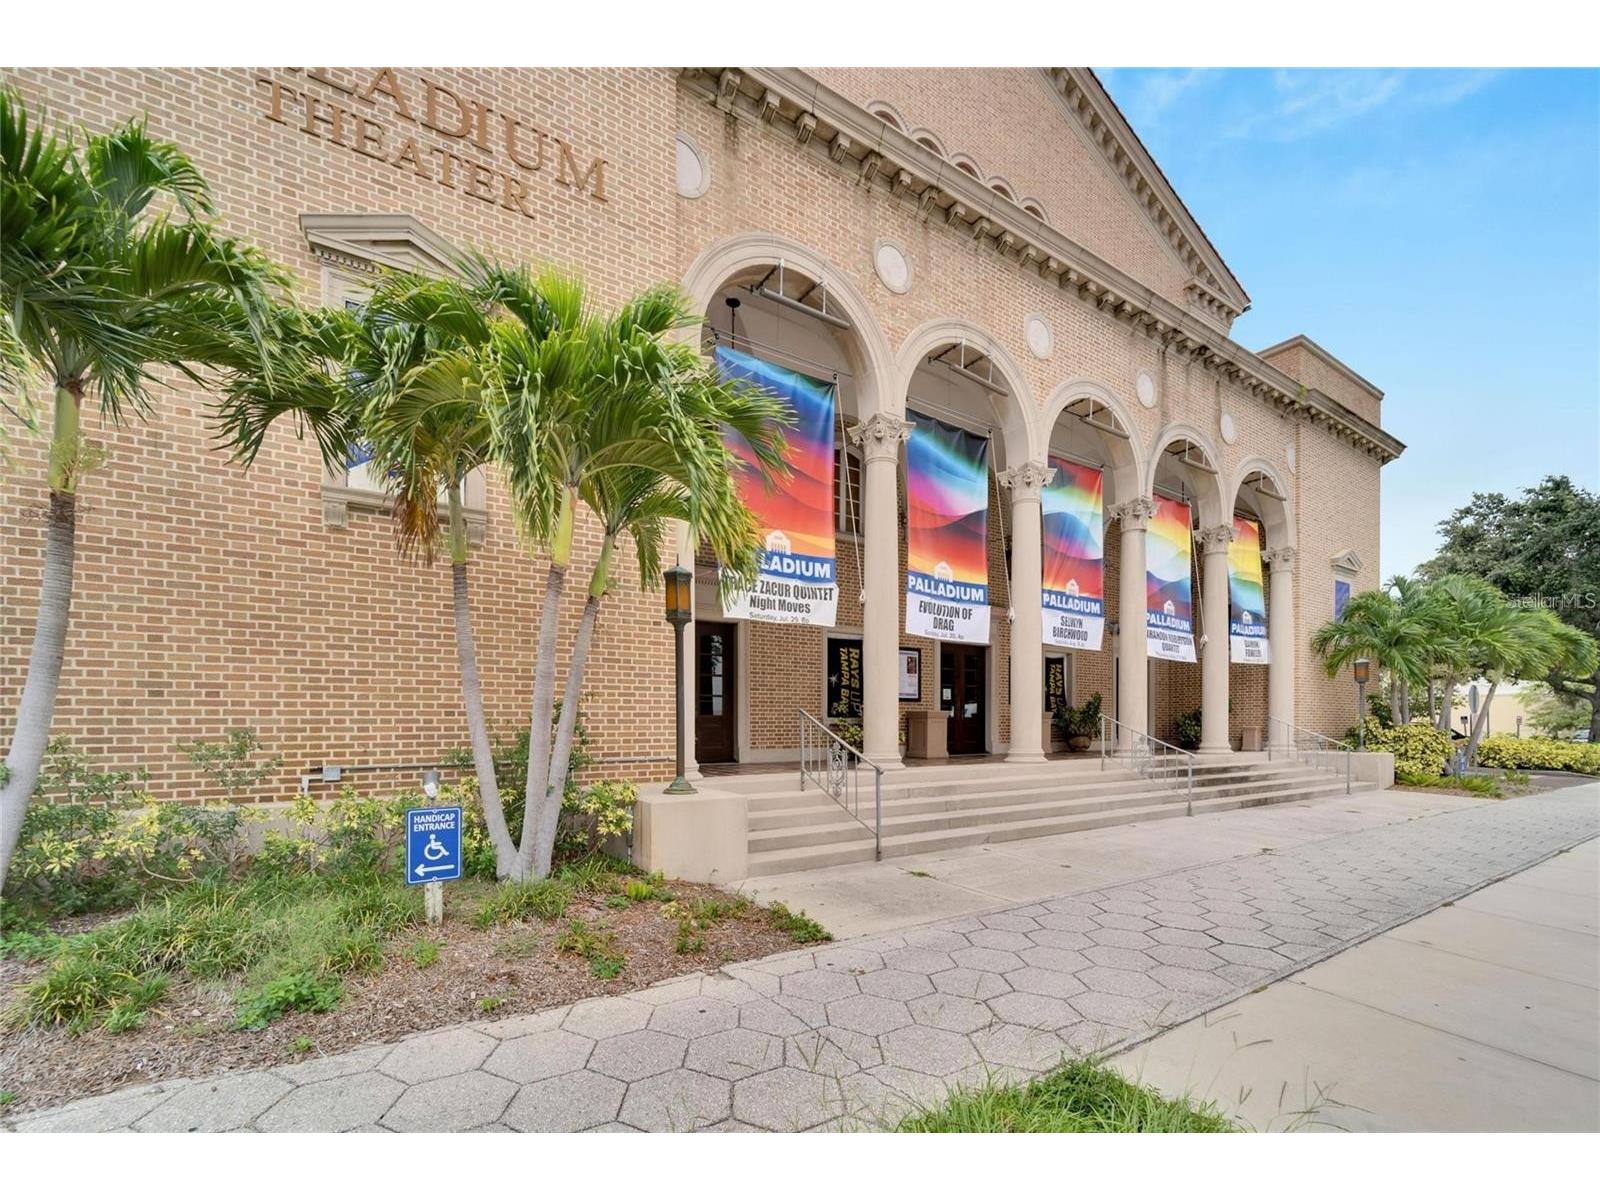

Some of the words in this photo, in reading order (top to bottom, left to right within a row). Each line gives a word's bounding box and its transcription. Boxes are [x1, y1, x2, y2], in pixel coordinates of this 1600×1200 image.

[256, 78, 535, 219] THEATER
[759, 552, 831, 579] LADIUM
[760, 580, 791, 598] ZACUR
[793, 584, 834, 602] QUINTET
[907, 574, 984, 602] PALLADIUM
[750, 595, 776, 612] Night
[778, 599, 811, 614] Moves
[919, 600, 960, 619] EVOLUTION
[962, 607, 973, 620] OF
[1042, 592, 1101, 614] PALLADIUM
[933, 617, 955, 631] DRAG
[1146, 612, 1190, 632] PALLADIUM
[1052, 626, 1088, 641] BIRCHWOOD
[839, 647, 850, 686] TAMPA
[849, 647, 860, 689] RAYS
[413, 813, 455, 824] HANDICAP
[413, 821, 455, 832] ENTRANCE
